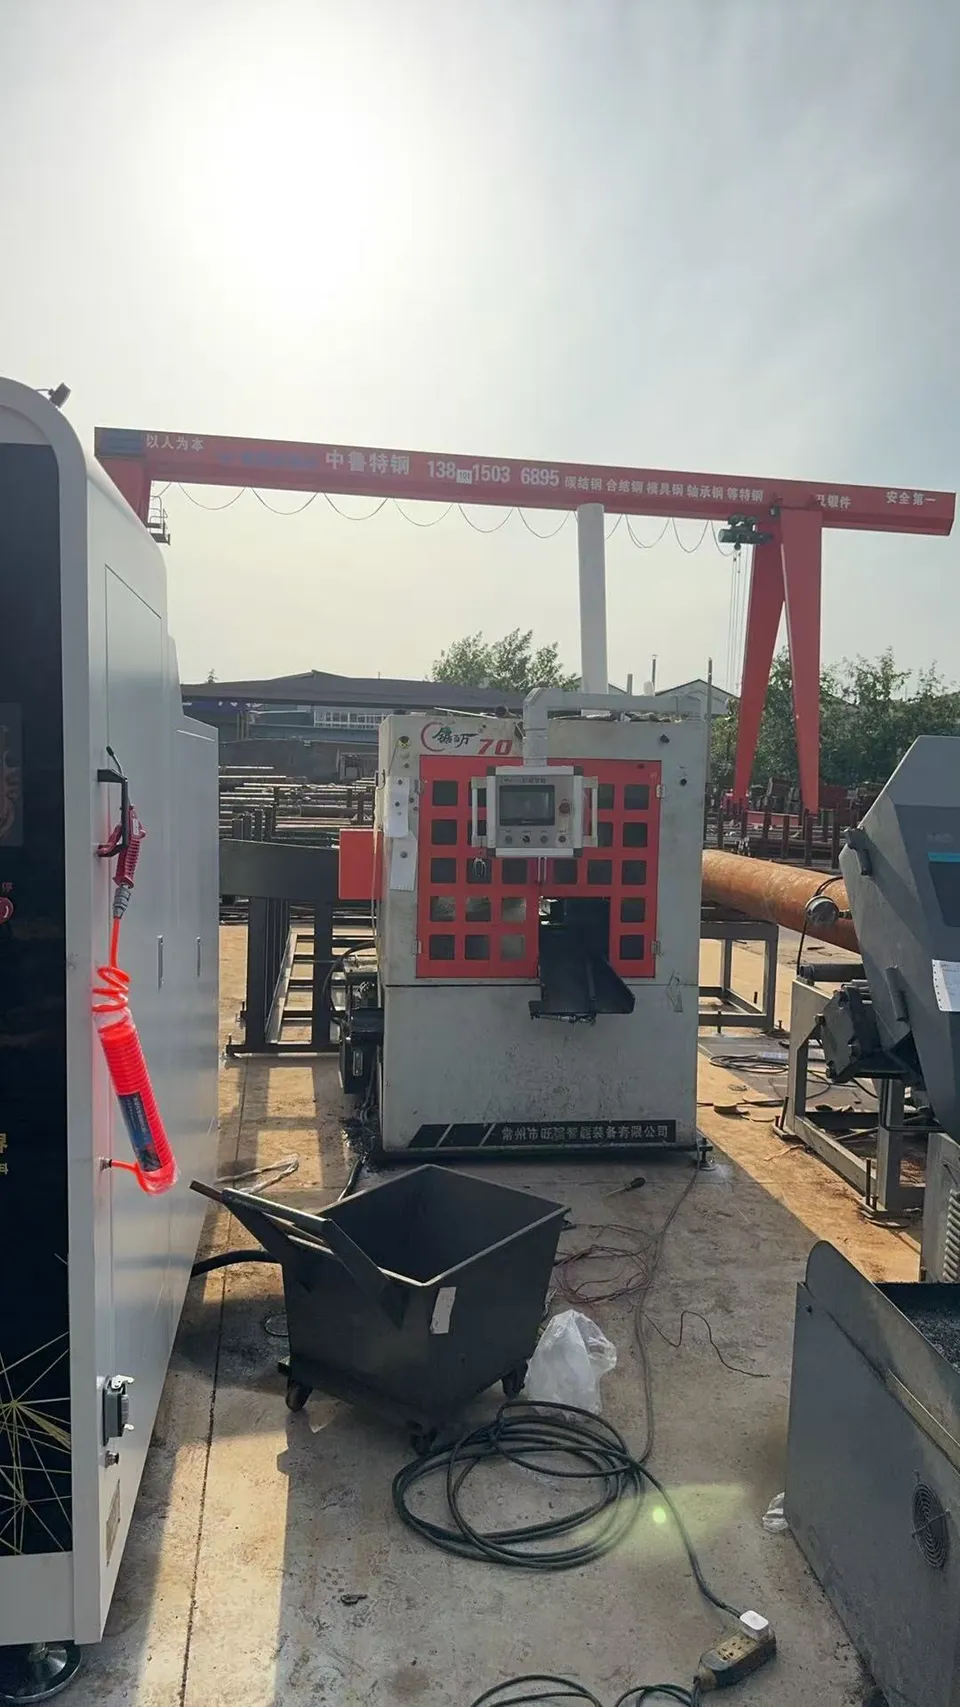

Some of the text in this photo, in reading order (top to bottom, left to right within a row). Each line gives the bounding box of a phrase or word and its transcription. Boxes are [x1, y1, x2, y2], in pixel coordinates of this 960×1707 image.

[146, 434, 204, 452] 以人为本
[325, 449, 410, 476] 中鲁特钢
[427, 460, 456, 479] 138
[472, 464, 511, 483] 1503
[520, 467, 560, 487] 6895
[686, 484, 724, 500] 轴承钢
[886, 490, 937, 506] 安全第一
[477, 739, 513, 755] 70
